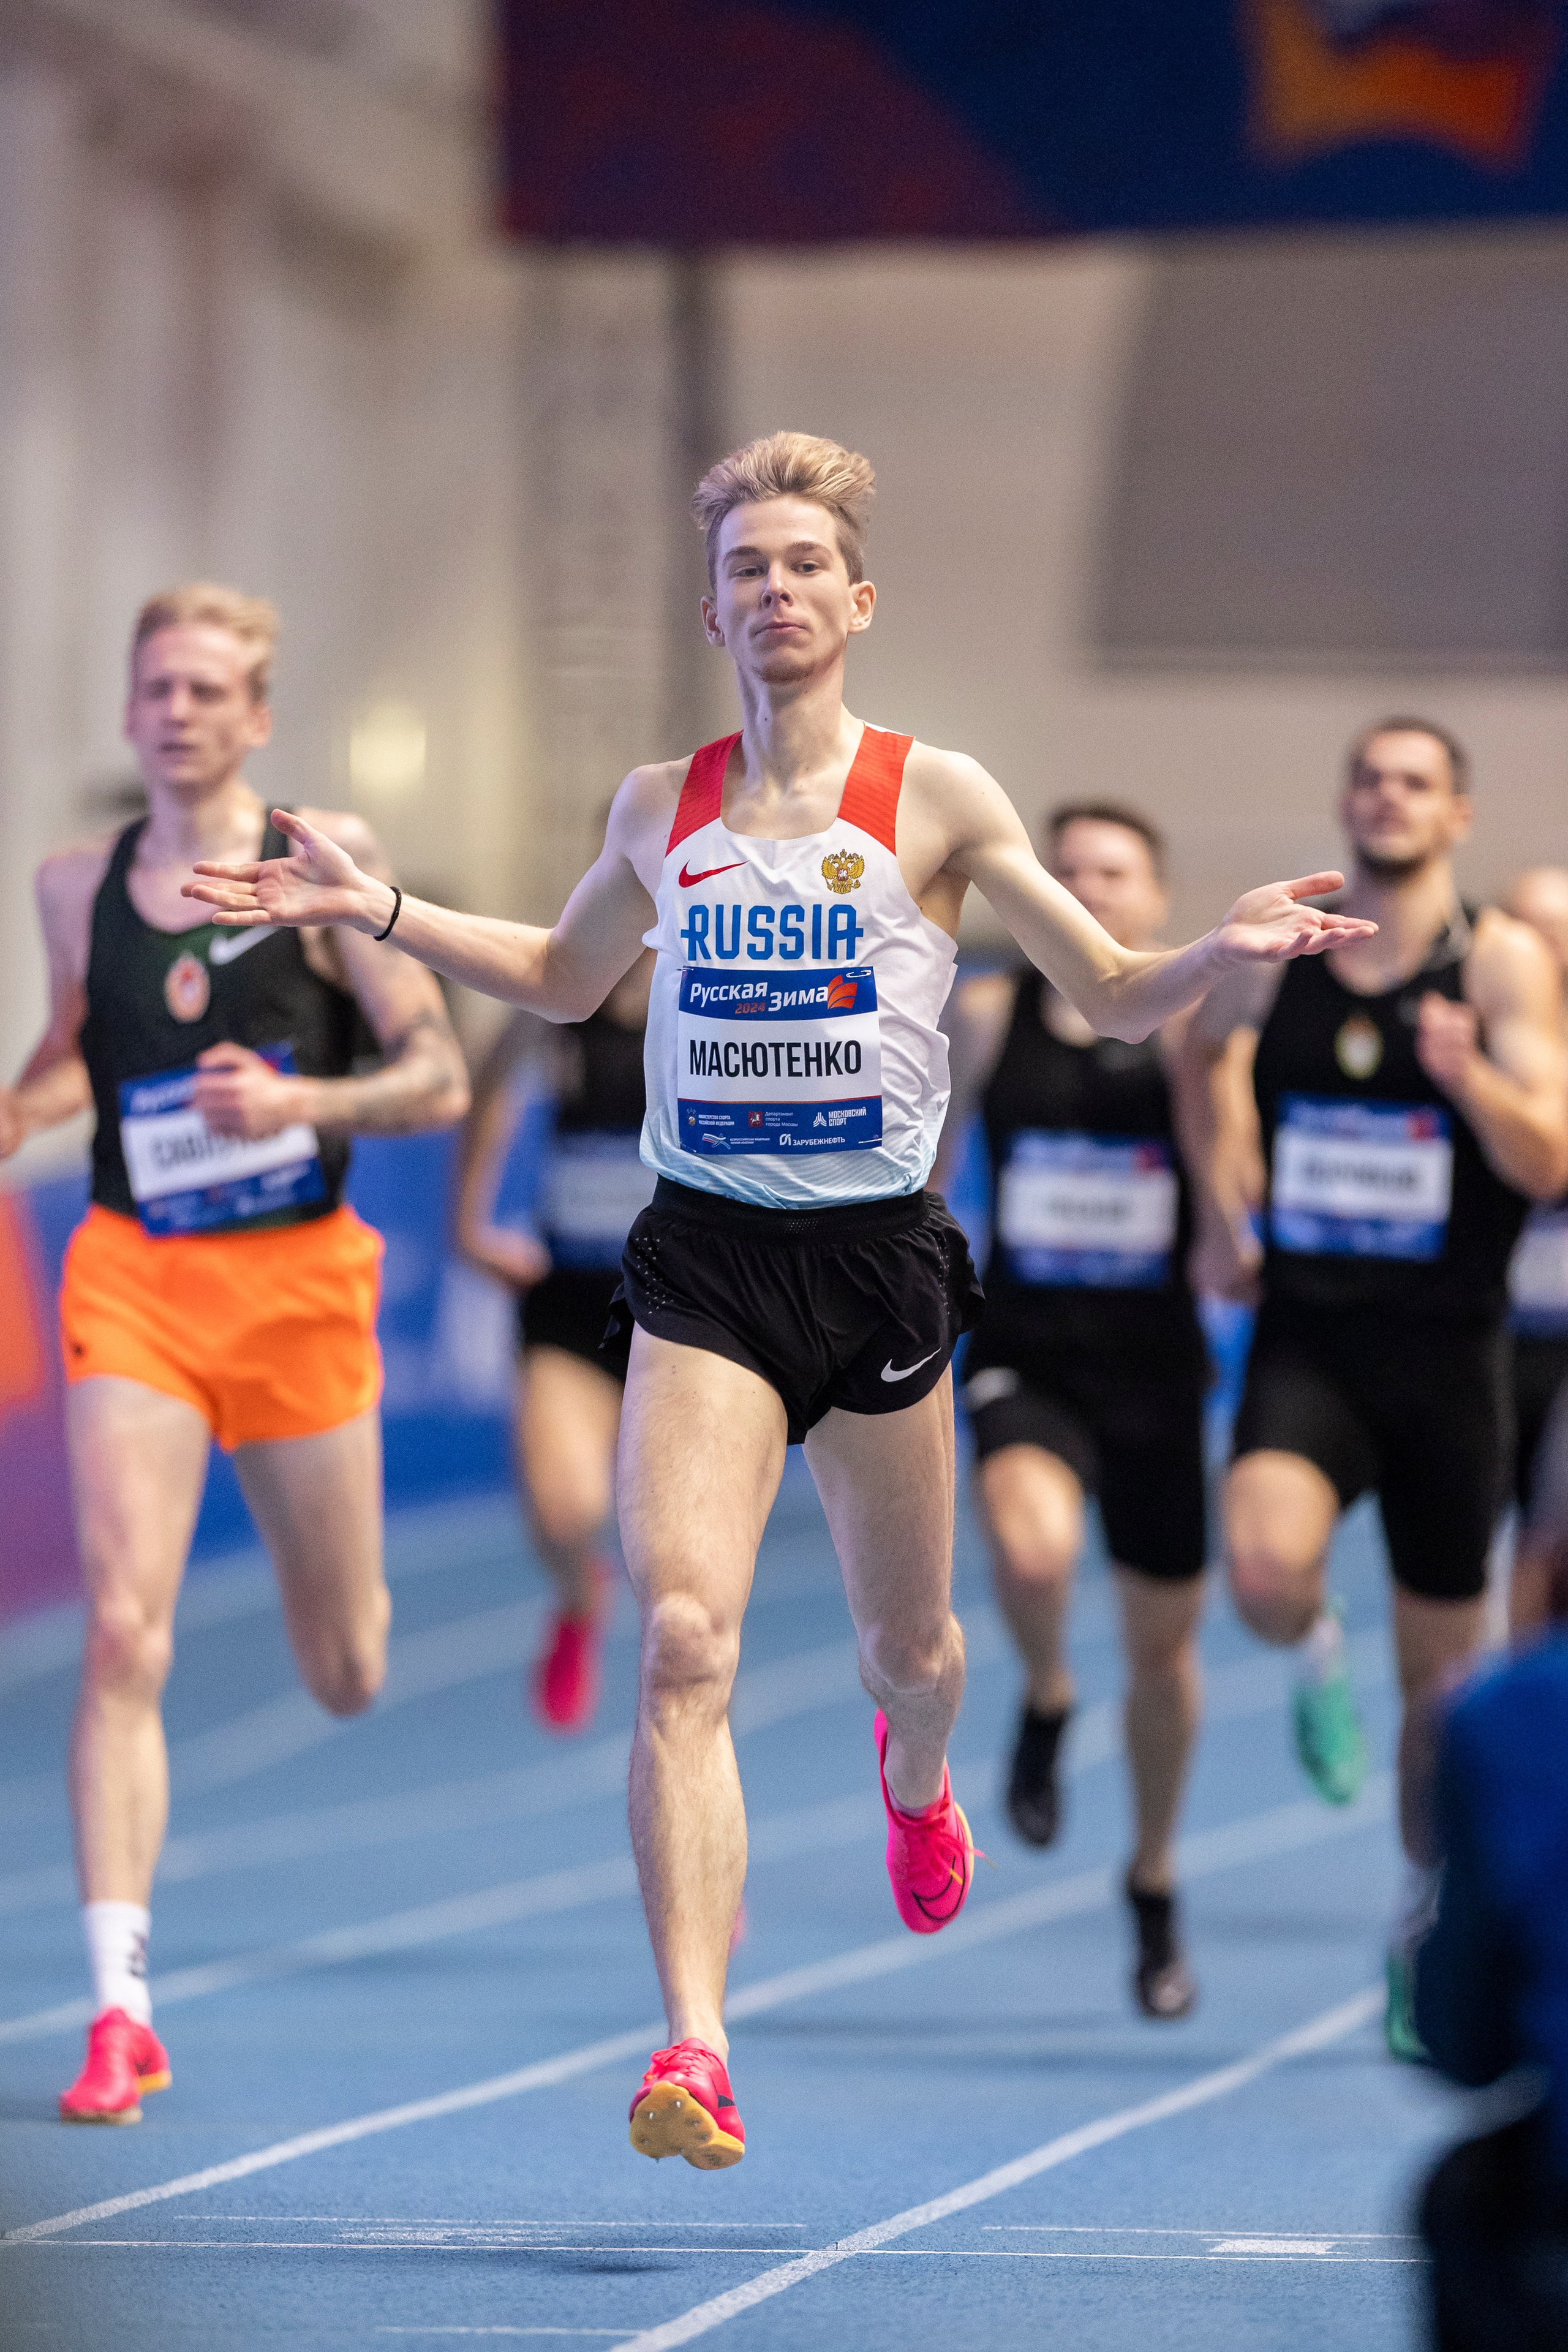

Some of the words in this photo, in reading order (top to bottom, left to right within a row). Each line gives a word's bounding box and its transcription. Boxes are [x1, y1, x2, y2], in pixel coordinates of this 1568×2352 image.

[681, 903, 864, 961] RUSSIA
[690, 982, 768, 1008] Русская
[768, 986, 829, 1012] Зима
[735, 1002, 766, 1014] 2024
[690, 1039, 862, 1077] МАСЮТЕНКО
[828, 1107, 867, 1118] МОСКОВСКИЙ
[829, 1118, 846, 1126] СПОРТ
[793, 1137, 845, 1146] ЗАРУБЕЖНЕФТЬ
